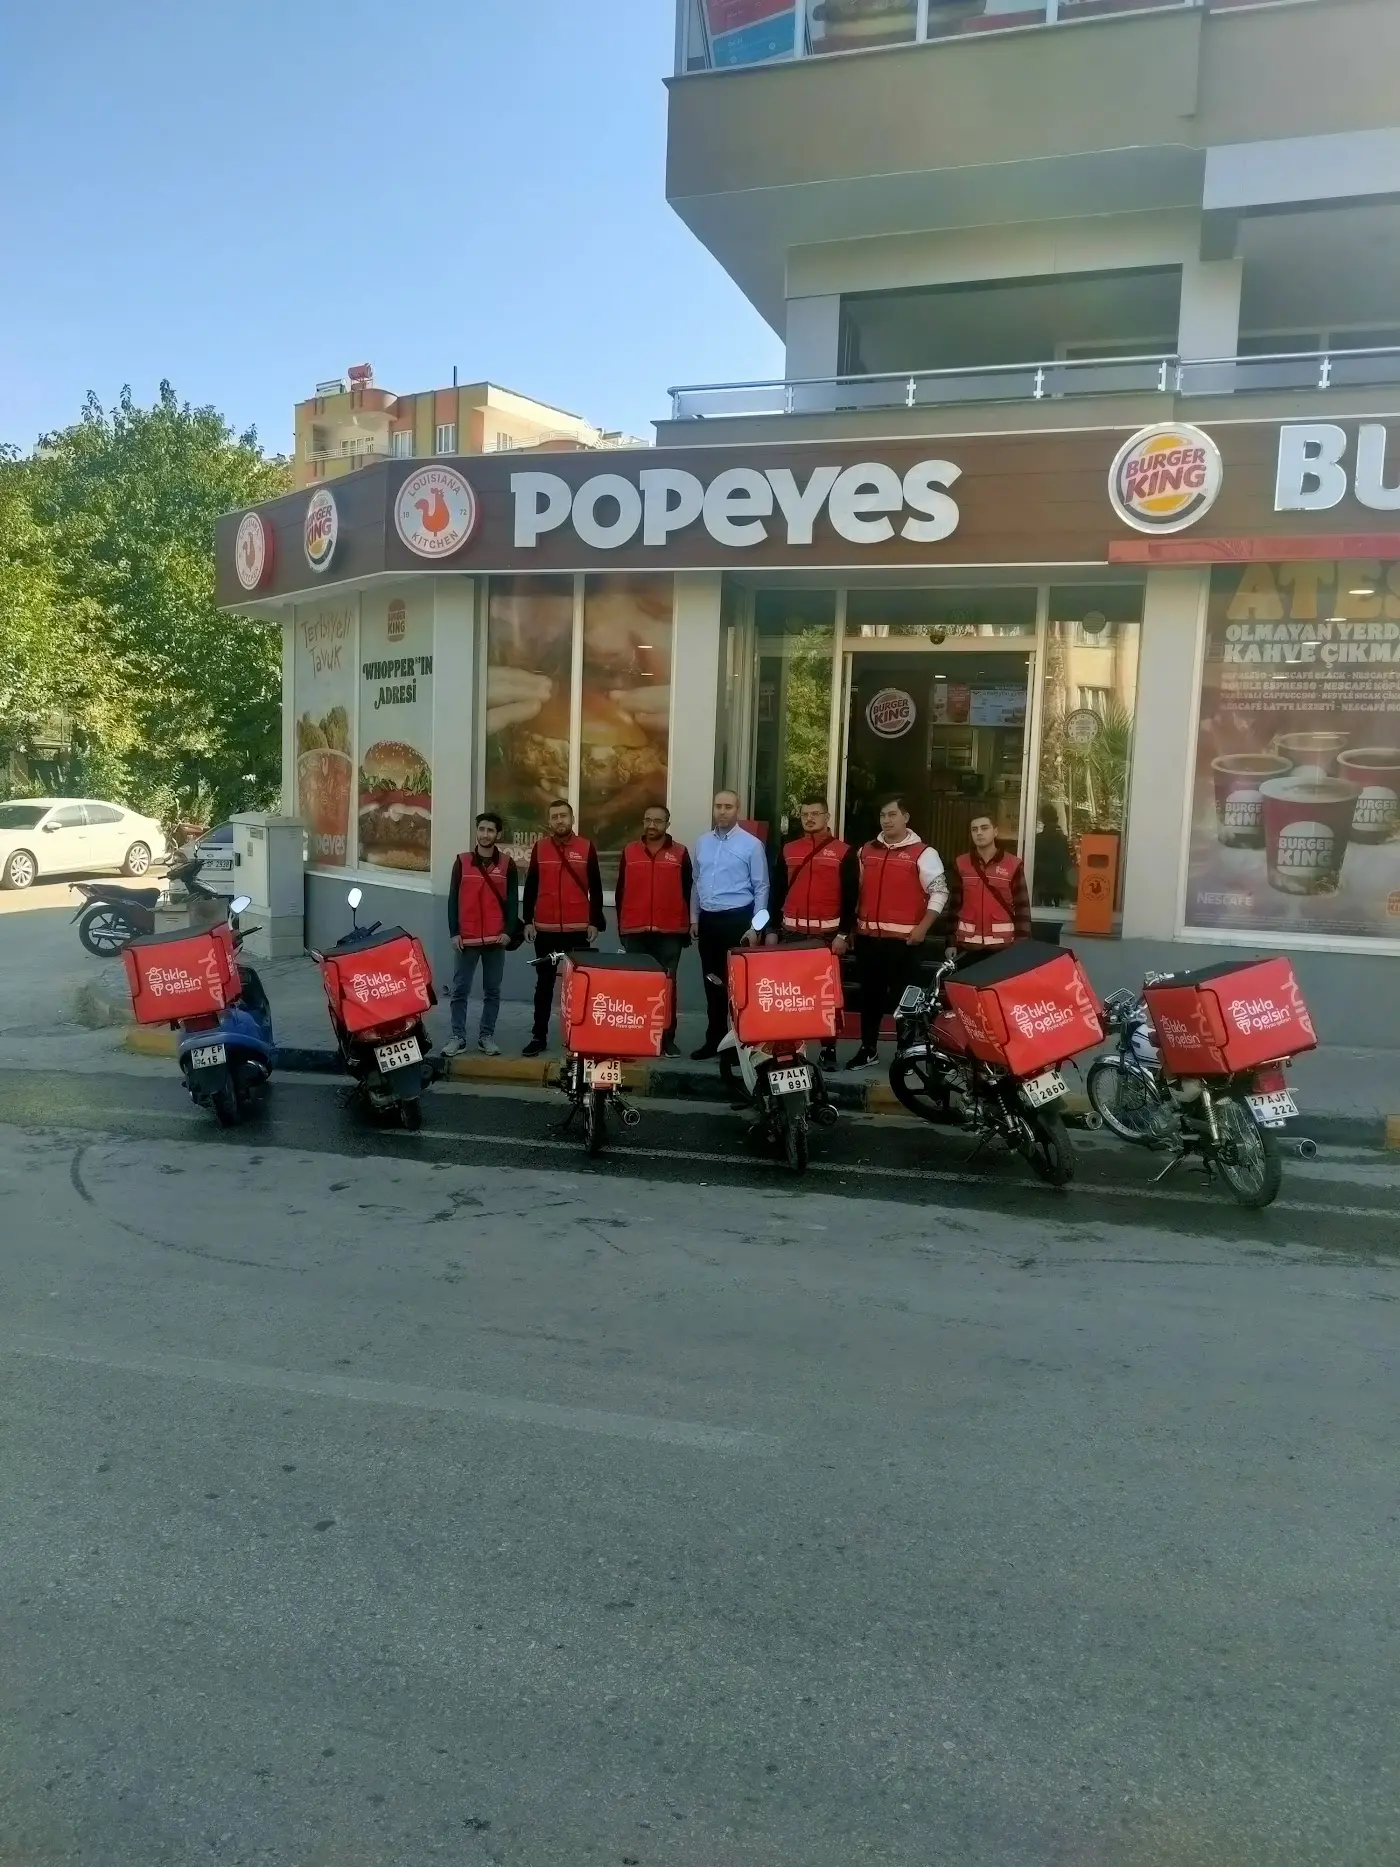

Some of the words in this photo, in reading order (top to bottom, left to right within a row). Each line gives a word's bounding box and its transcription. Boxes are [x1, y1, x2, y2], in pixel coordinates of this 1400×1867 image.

[1125, 447, 1205, 480] BURGER
[408, 473, 462, 497] LOUISIANA
[1124, 465, 1207, 505] KING
[403, 511, 410, 519] 19
[459, 508, 468, 516] 72
[411, 530, 459, 549] KITCHEN
[388, 620, 405, 634] KING
[1225, 623, 1332, 642] OLMAYAN
[1223, 643, 1316, 663] KAHVE
[374, 678, 416, 710] ADRESİ
[873, 699, 909, 715] BURGER
[874, 707, 910, 727] KING
[1278, 837, 1333, 850] BURGER
[1277, 849, 1333, 866] KING
[165, 977, 202, 995] gelsin
[371, 980, 407, 1000] gelsin
[775, 996, 815, 1012] gelsin
[607, 1013, 645, 1027] gelsin
[1034, 1007, 1073, 1033] gelsin
[1253, 1007, 1290, 1031] gelsin
[211, 1046, 222, 1054] EP
[201, 1056, 218, 1066] 415
[389, 1053, 411, 1067] 619
[607, 1060, 619, 1070] JE
[600, 1072, 619, 1081] 493
[788, 1079, 807, 1090] 891
[1026, 1079, 1039, 1092] 27
[1039, 1082, 1065, 1100] 2860
[1271, 1104, 1295, 1116] 222
